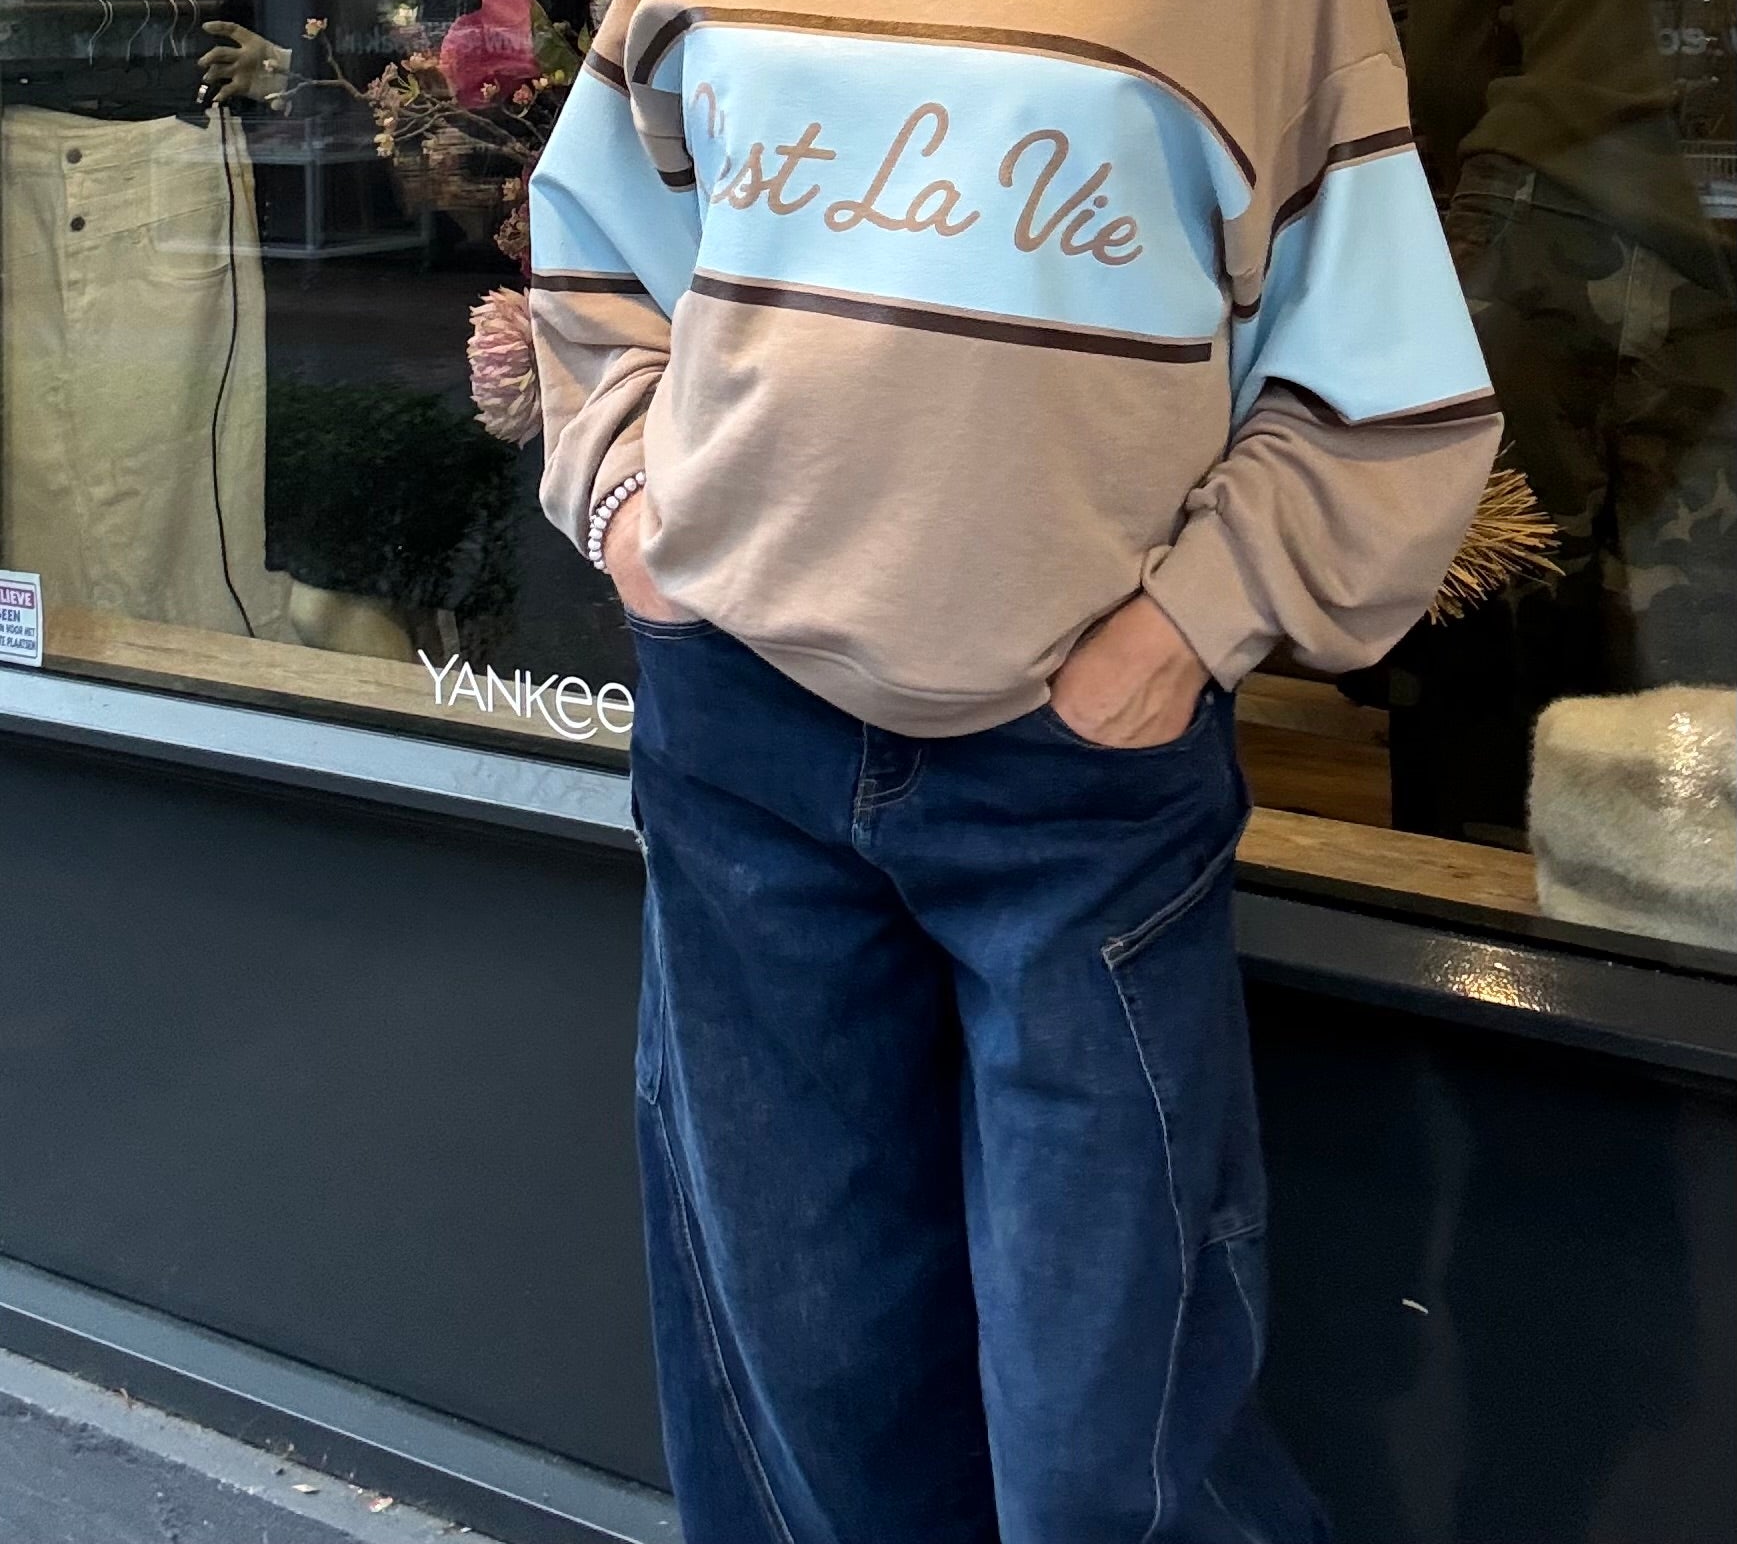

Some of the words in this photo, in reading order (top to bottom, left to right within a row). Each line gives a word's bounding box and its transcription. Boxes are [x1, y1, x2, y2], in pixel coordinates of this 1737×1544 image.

[826, 102, 980, 237] La
[998, 129, 1144, 267] Vie
[0, 609, 20, 622] EEN
